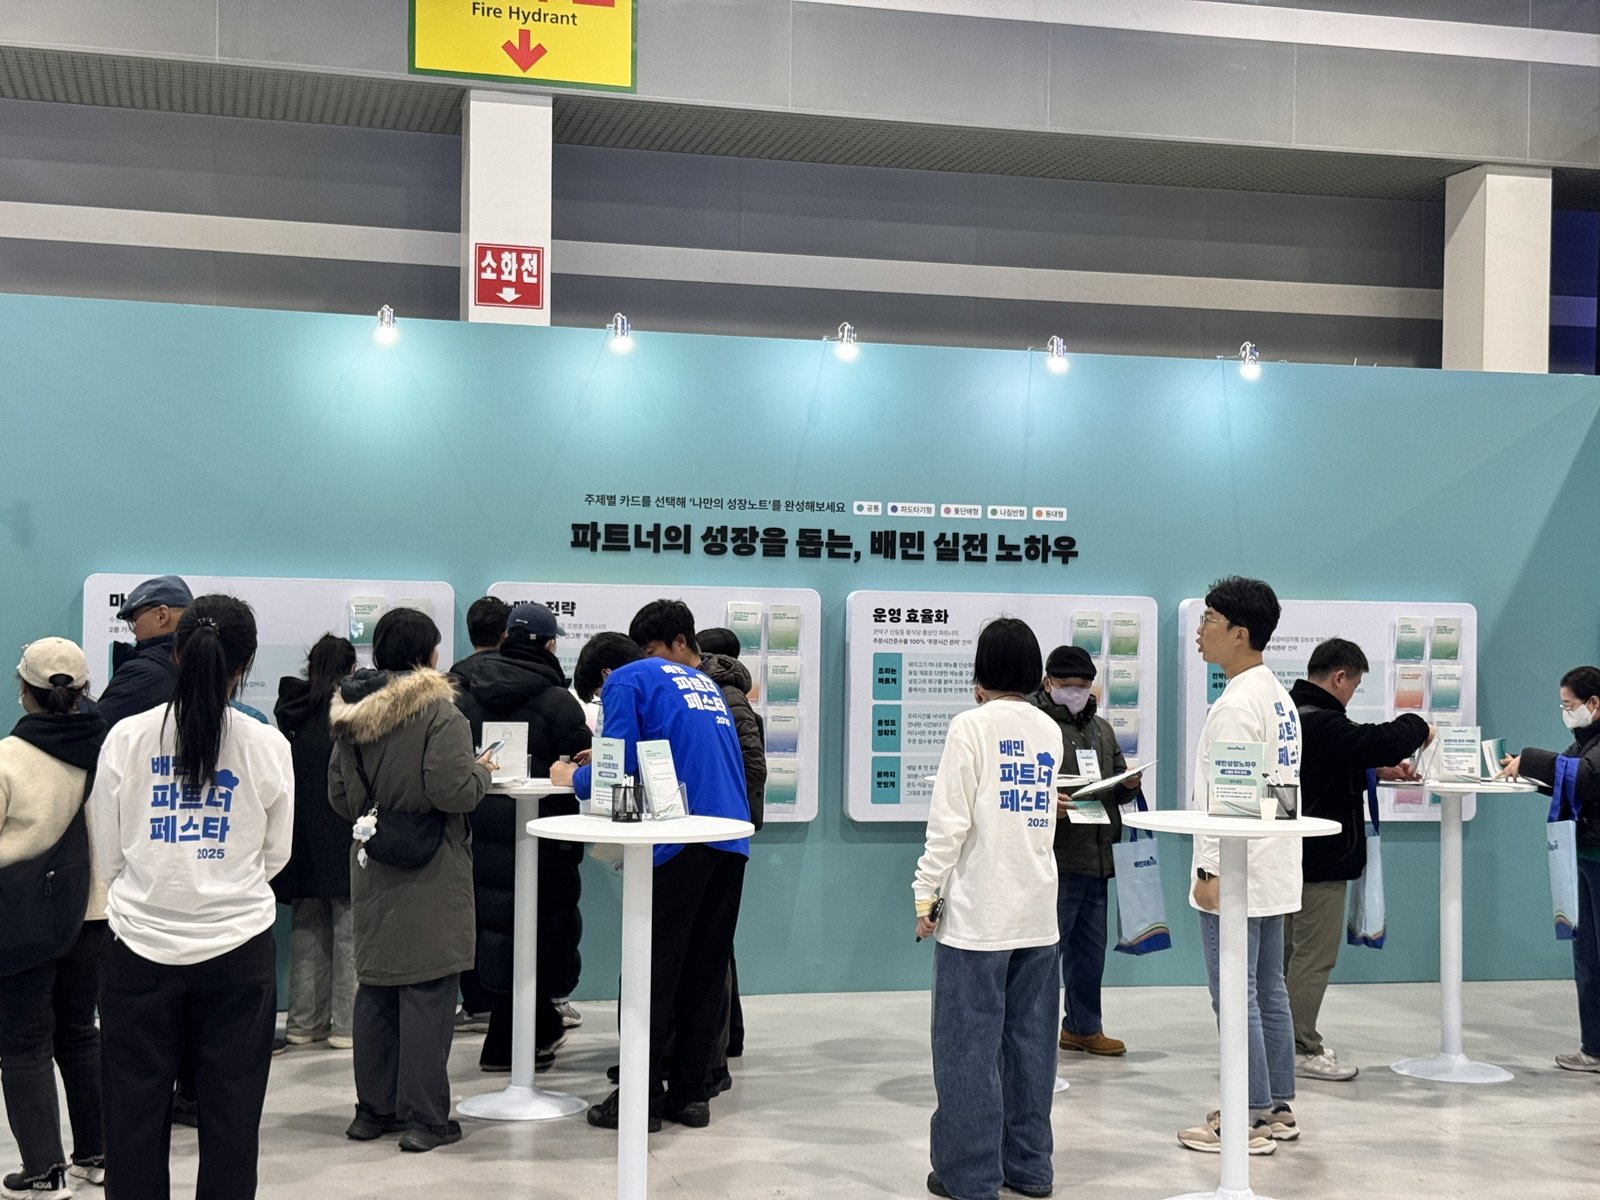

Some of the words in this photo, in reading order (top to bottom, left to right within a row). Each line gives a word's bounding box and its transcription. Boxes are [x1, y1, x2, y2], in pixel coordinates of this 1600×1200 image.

[472, 2, 503, 19] Fire
[509, 5, 578, 26] Hydrant
[480, 250, 538, 284] 소화전
[584, 493, 617, 507] 주제별
[619, 494, 652, 508] 카드를
[654, 495, 687, 509] 선택해
[784, 499, 846, 514] 완성해보세요
[866, 503, 880, 513] 공통
[900, 505, 933, 515] 파도타기형
[999, 508, 1025, 518] 나침반형
[1045, 509, 1064, 519] 등대형
[570, 521, 692, 555] 파트너의
[700, 525, 789, 558] 성장을
[796, 528, 861, 564] 돕는,
[870, 529, 925, 561] 배민
[933, 532, 988, 563] 실전
[995, 534, 1079, 565] 노하우
[545, 601, 577, 617] 전략
[872, 607, 902, 623] 운영
[905, 608, 949, 624] 효율화
[683, 692, 728, 716] 페스타
[999, 739, 1025, 757] 배민
[999, 762, 1053, 788] 파트너
[151, 782, 233, 813] 파트너
[999, 789, 1050, 814] 페스타
[150, 815, 231, 844] 페스타
[1027, 817, 1049, 828] 2025
[197, 848, 225, 860] 2025
[32, 1181, 53, 1190] HOKA
